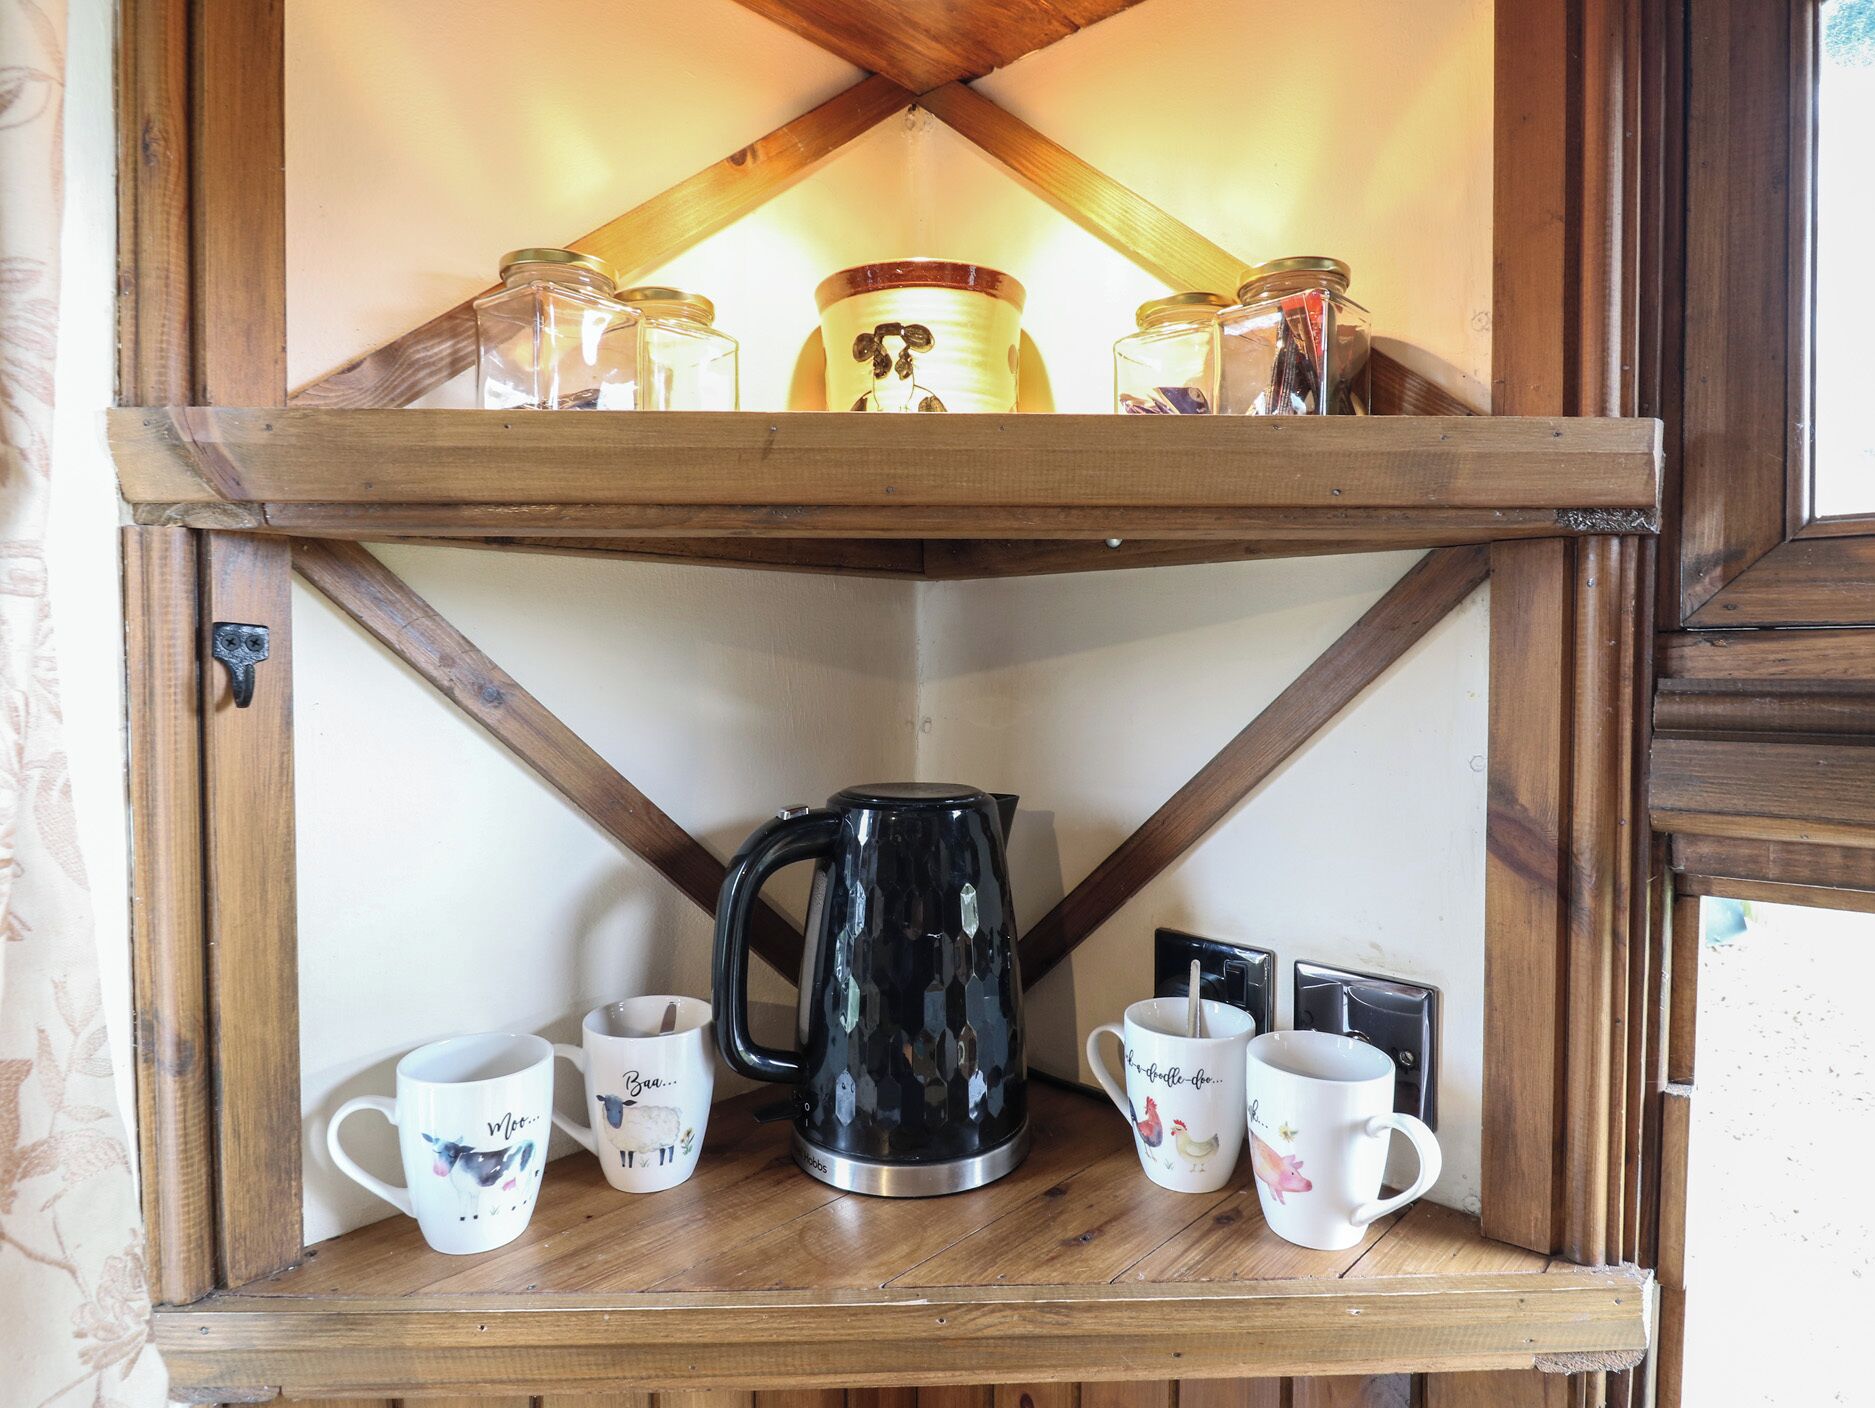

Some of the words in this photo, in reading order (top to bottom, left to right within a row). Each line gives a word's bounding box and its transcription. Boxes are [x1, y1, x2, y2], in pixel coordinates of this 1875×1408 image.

[623, 1070, 677, 1097] Baa...
[1125, 1049, 1223, 1090] k-a-doodle-doo...
[487, 1112, 540, 1141] Moo...
